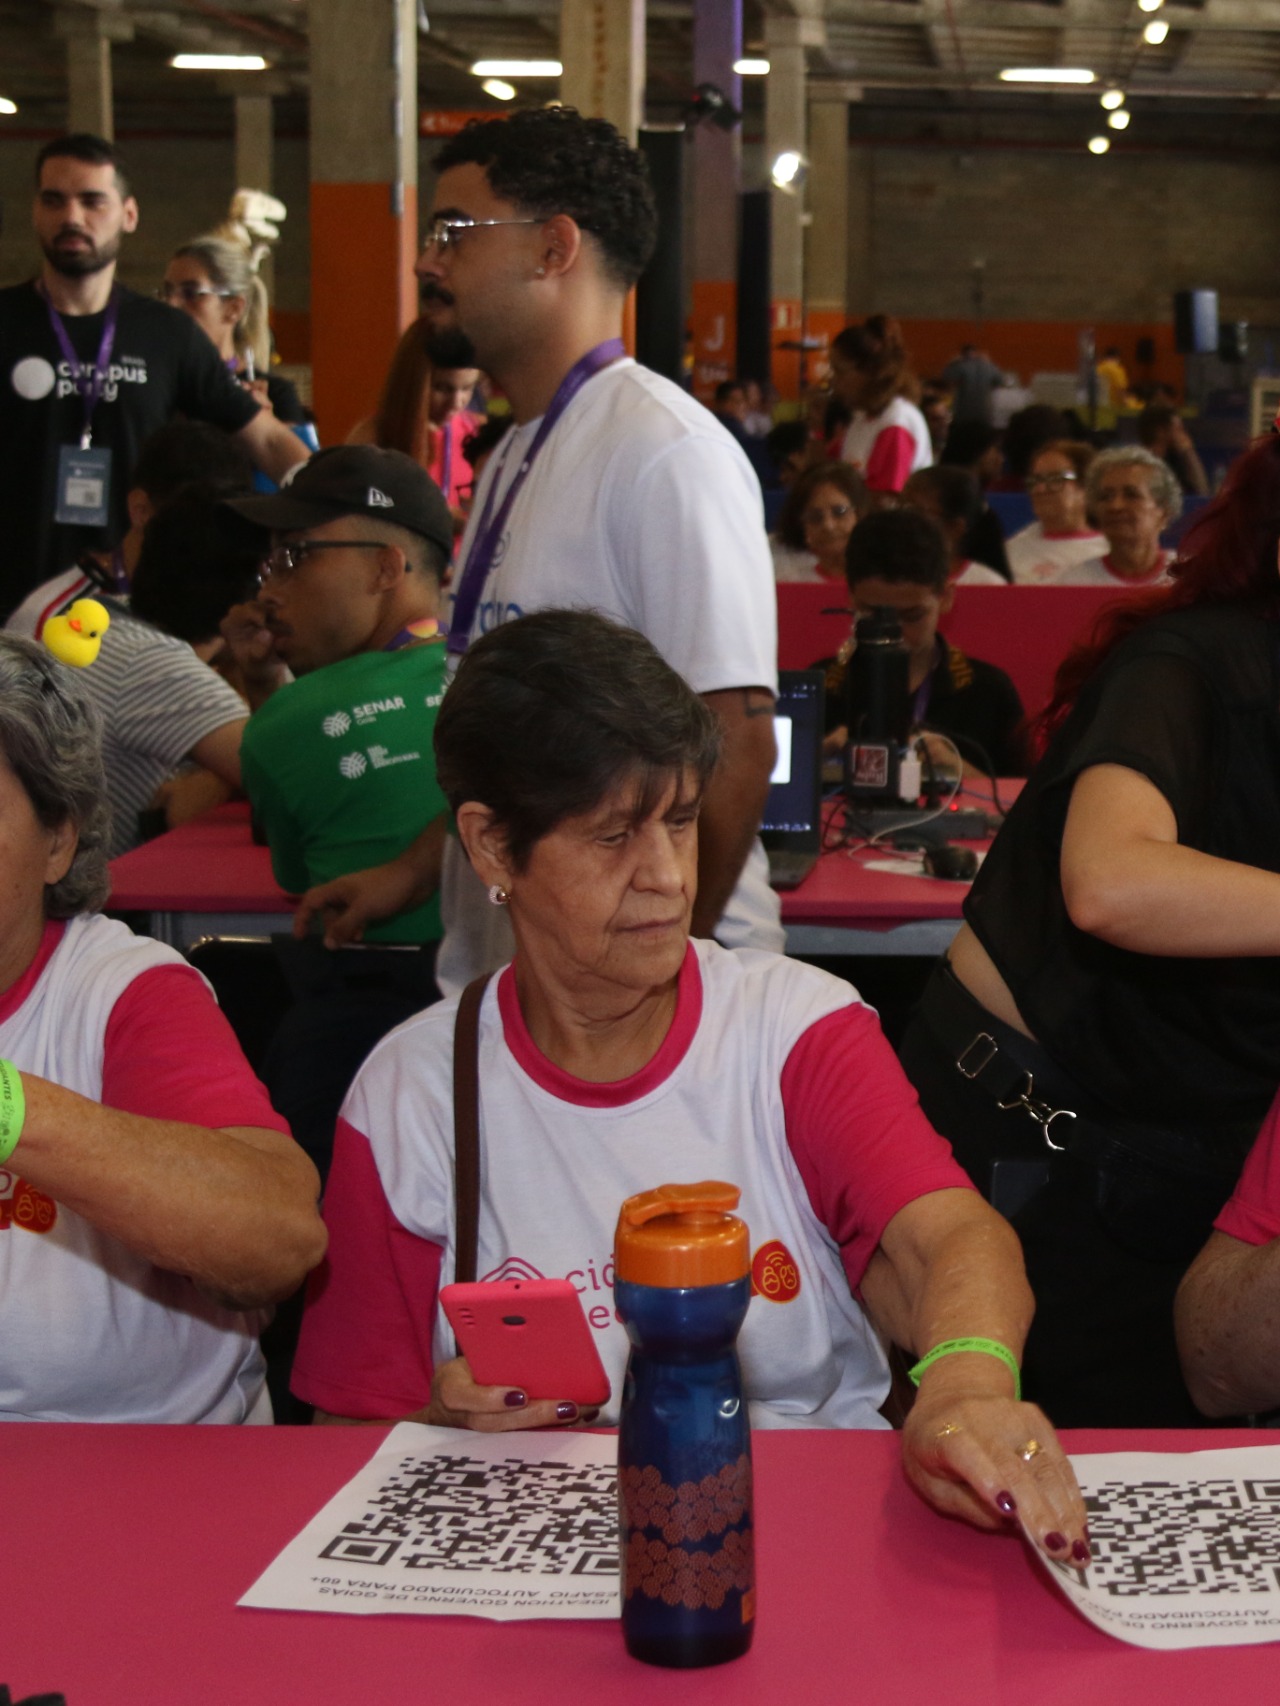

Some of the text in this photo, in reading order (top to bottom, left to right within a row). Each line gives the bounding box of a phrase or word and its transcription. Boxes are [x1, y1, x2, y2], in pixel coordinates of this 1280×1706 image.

[58, 361, 148, 384] cpus
[352, 696, 406, 719] SENAR
[310, 1576, 619, 1598] ESAFIO AUTOCUIDADO PARA 60+
[383, 1593, 408, 1601] DE
[414, 1593, 508, 1606] GOVERNO
[1129, 1609, 1270, 1620] AUTOCUIDADO
[1151, 1619, 1248, 1630] GOVERNO
